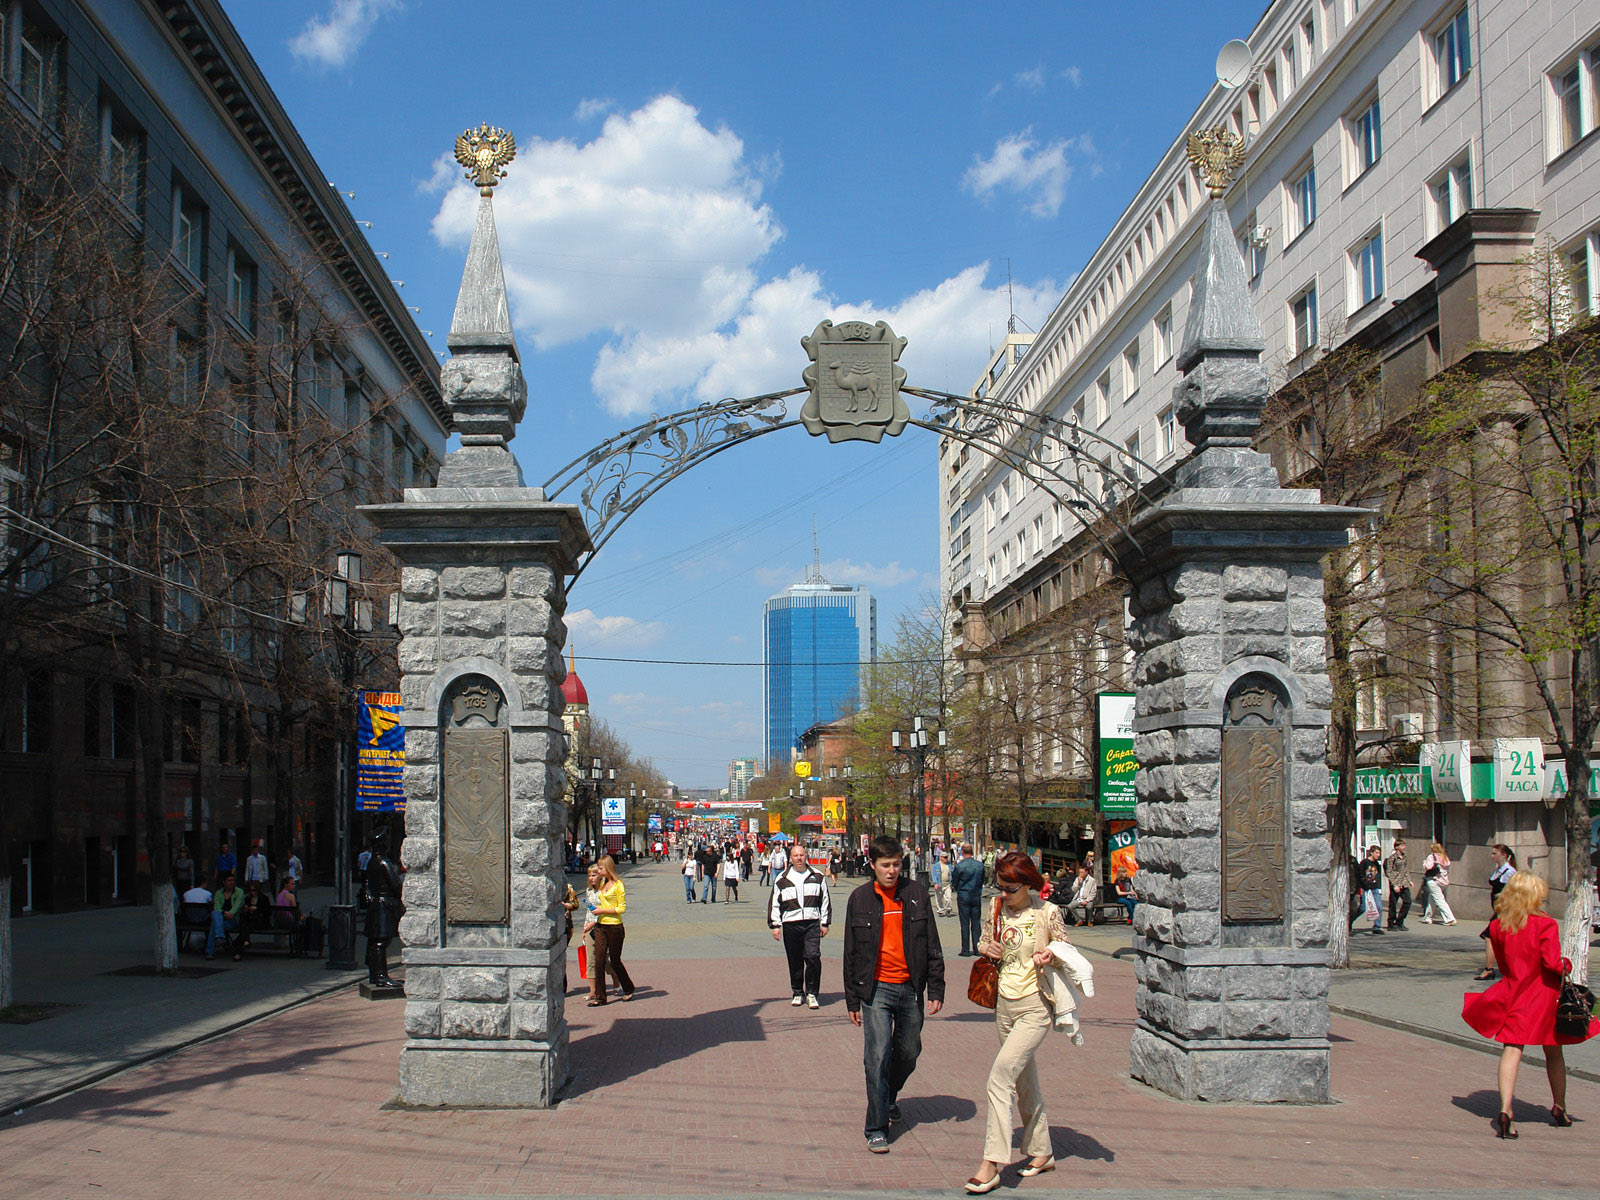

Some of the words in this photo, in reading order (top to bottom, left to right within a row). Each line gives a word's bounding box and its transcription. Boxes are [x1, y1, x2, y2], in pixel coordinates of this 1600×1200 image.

[839, 323, 871, 339] 1736
[464, 696, 487, 708] 1736
[1438, 753, 1455, 777] 24
[1510, 751, 1536, 775] 24
[1436, 782, 1460, 792] ЧАСА
[1505, 781, 1539, 792] ЧАСА
